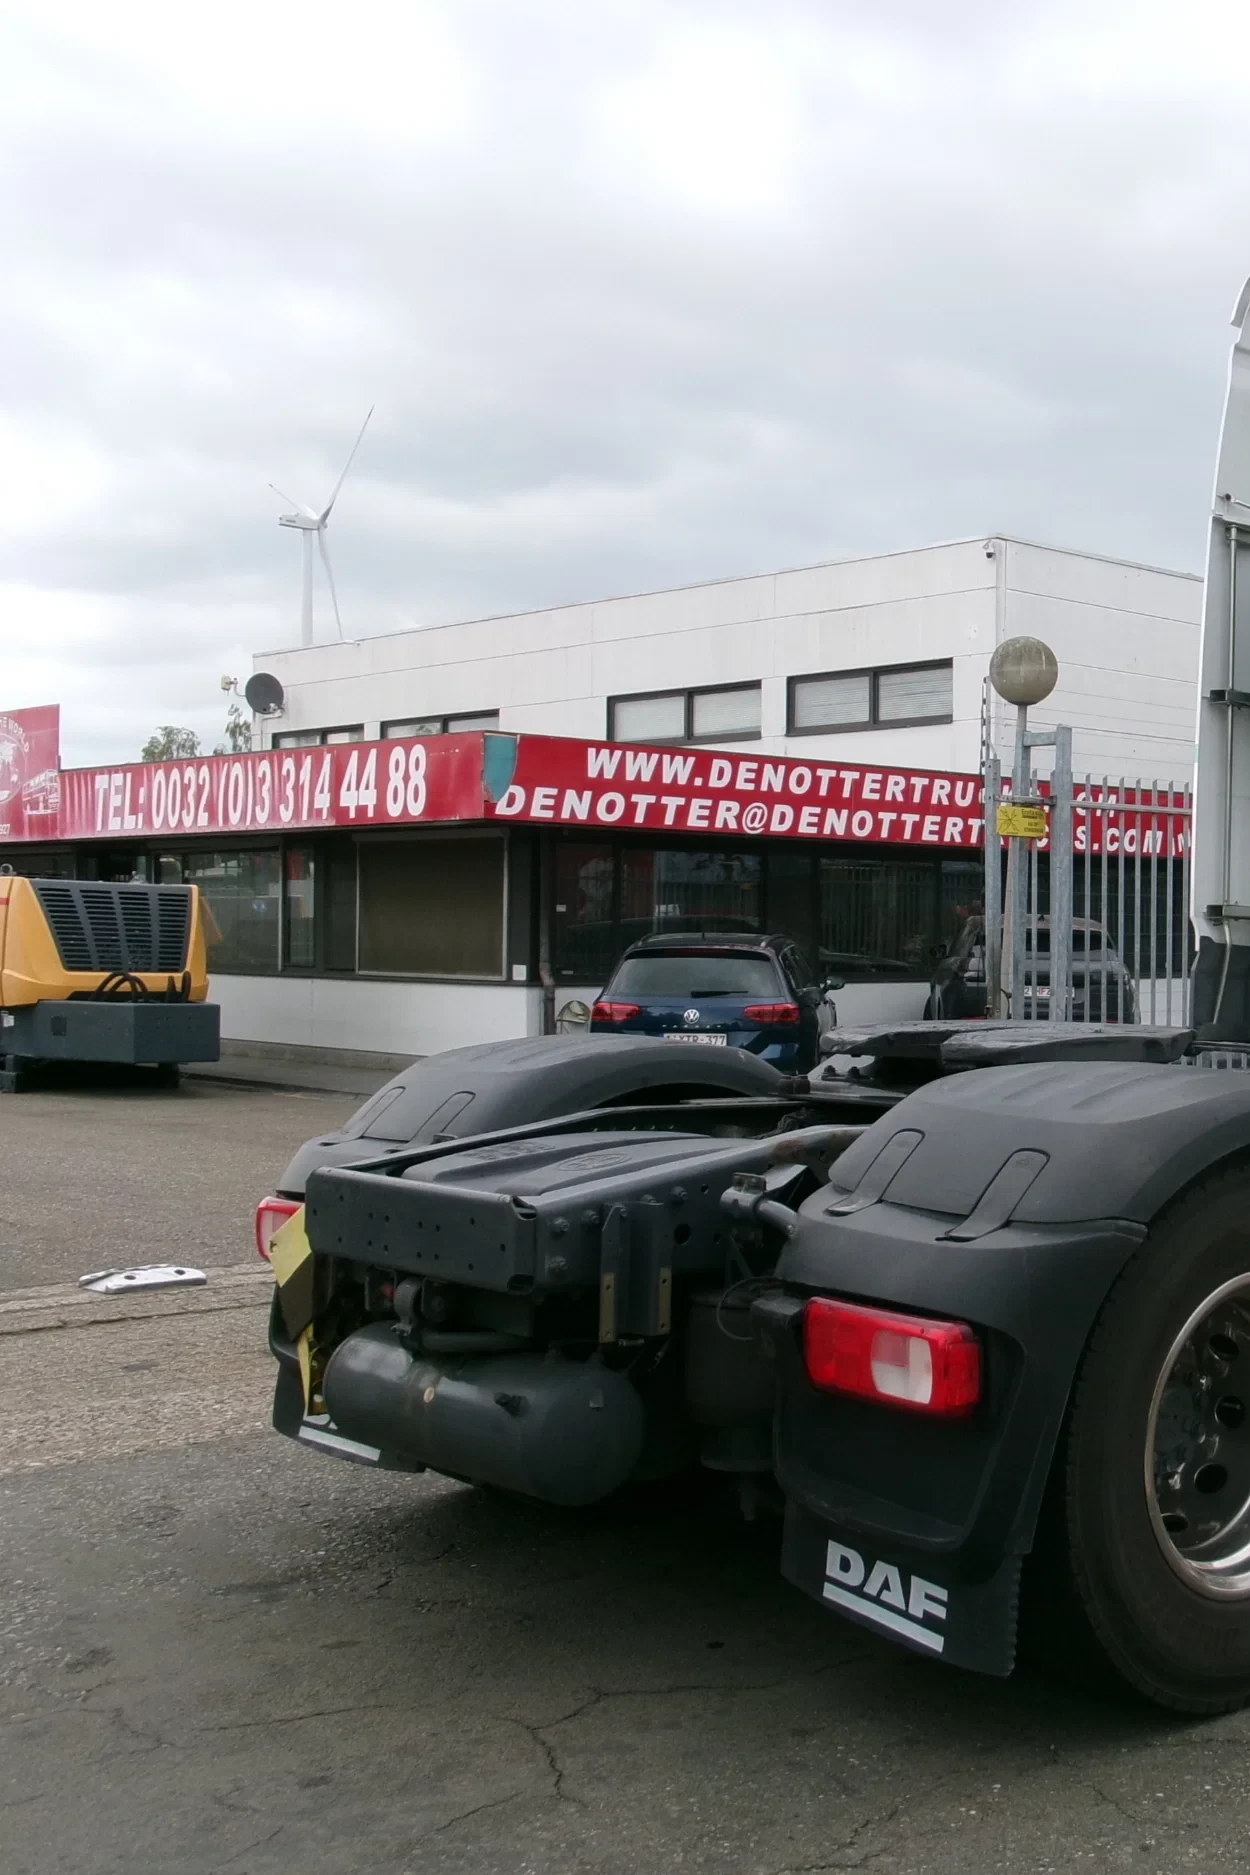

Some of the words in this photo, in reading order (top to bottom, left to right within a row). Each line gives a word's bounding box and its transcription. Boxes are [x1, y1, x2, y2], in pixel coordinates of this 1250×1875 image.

[95, 772, 145, 831] TEL:
[152, 765, 210, 829] 0032
[280, 753, 331, 822] 314
[340, 748, 377, 818] 44
[386, 744, 426, 817] 88
[495, 785, 1163, 854] DENOTTER@DENOTTERTS.COM
[826, 1540, 948, 1620] DAF
